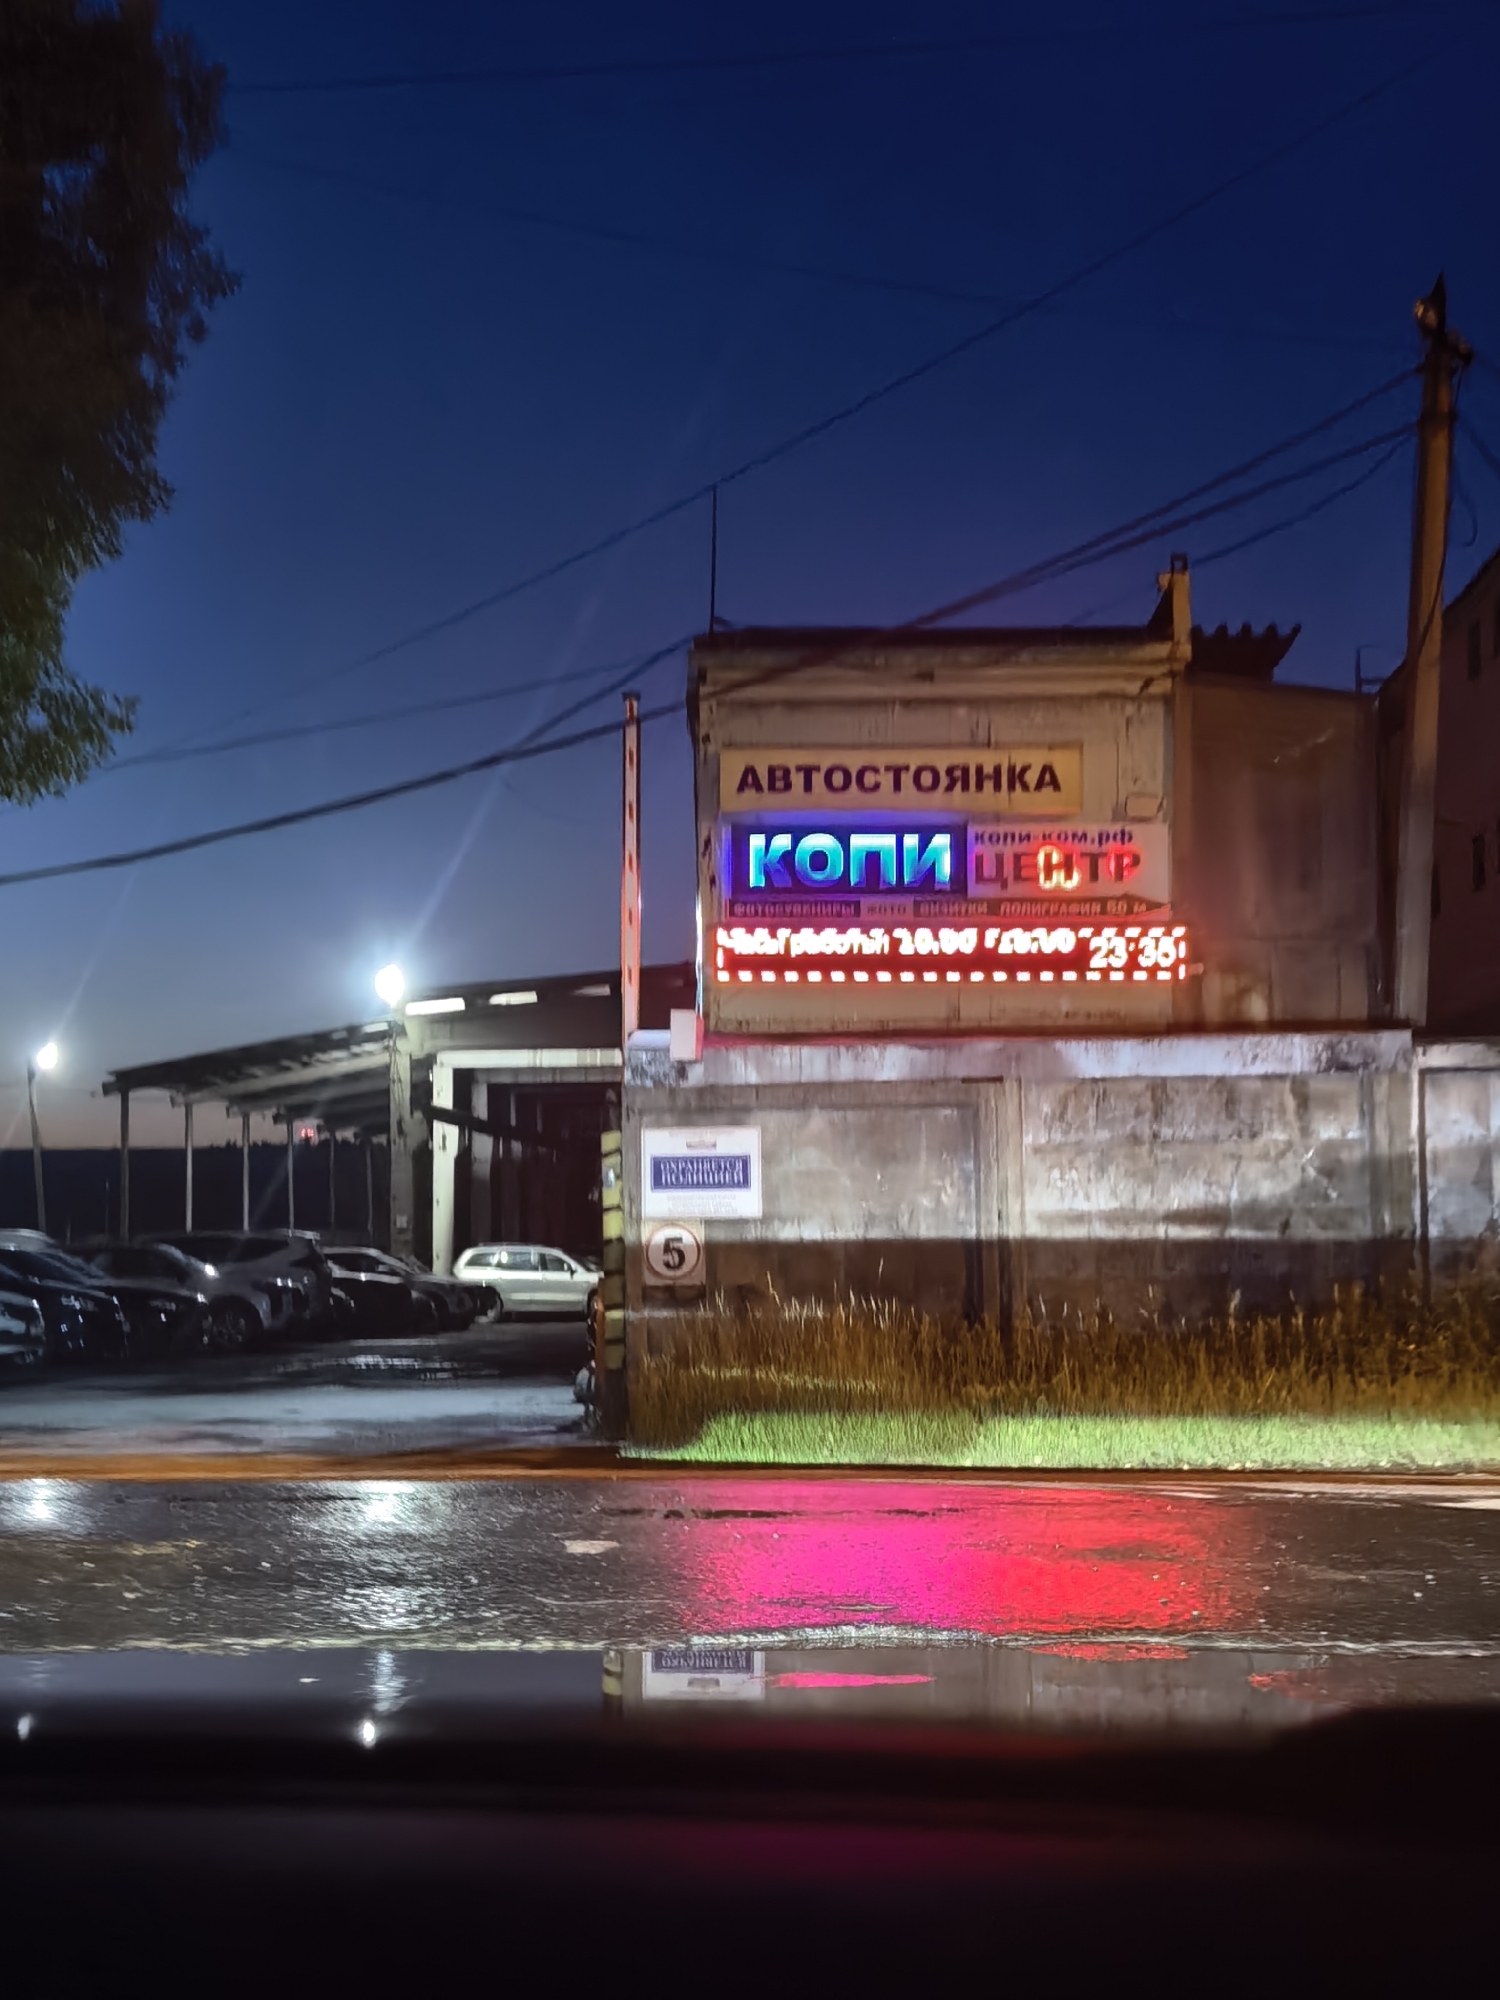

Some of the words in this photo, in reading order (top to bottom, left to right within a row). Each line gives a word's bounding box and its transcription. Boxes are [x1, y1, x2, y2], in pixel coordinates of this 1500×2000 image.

[736, 764, 1062, 793] АВТОСТОЯНКА
[749, 833, 951, 889] КОПИ
[974, 852, 1141, 890] ЦЕНТР
[662, 1237, 686, 1270] 5
